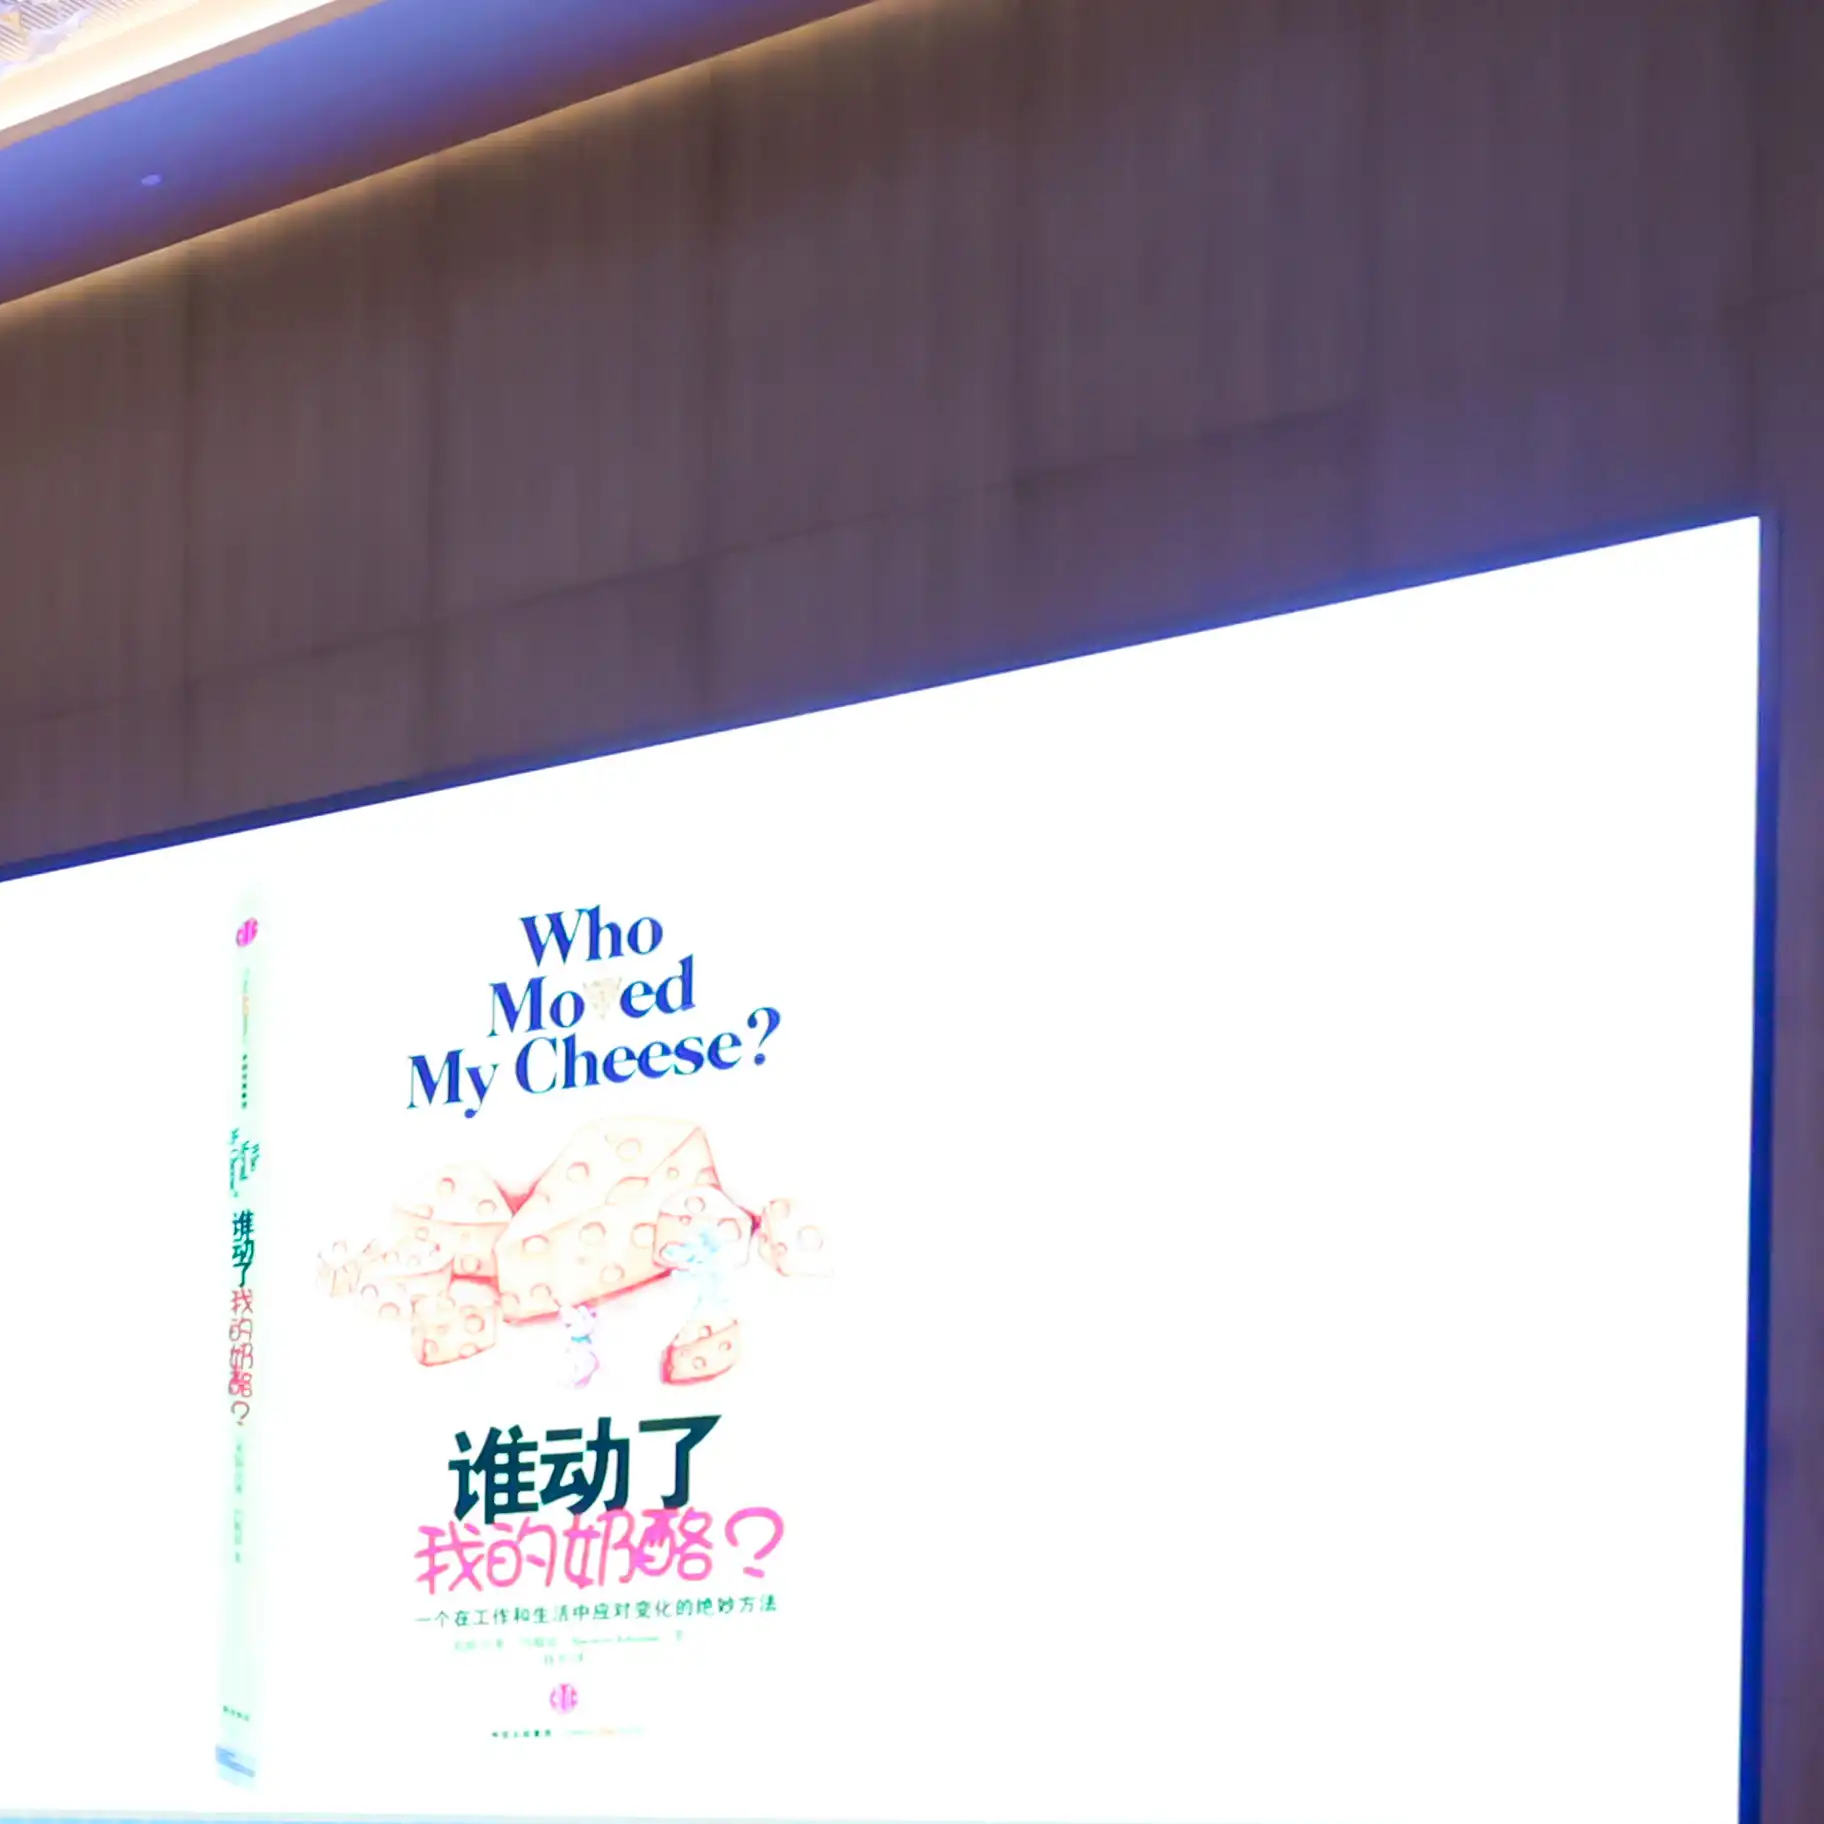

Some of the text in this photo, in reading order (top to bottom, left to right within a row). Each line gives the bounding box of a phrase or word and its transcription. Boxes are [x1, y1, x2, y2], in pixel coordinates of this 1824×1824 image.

[519, 904, 664, 967] Who
[407, 1006, 782, 1119] My Cheese?
[448, 1414, 722, 1525] 谁动了
[414, 1506, 784, 1595] 我的奶酪？
